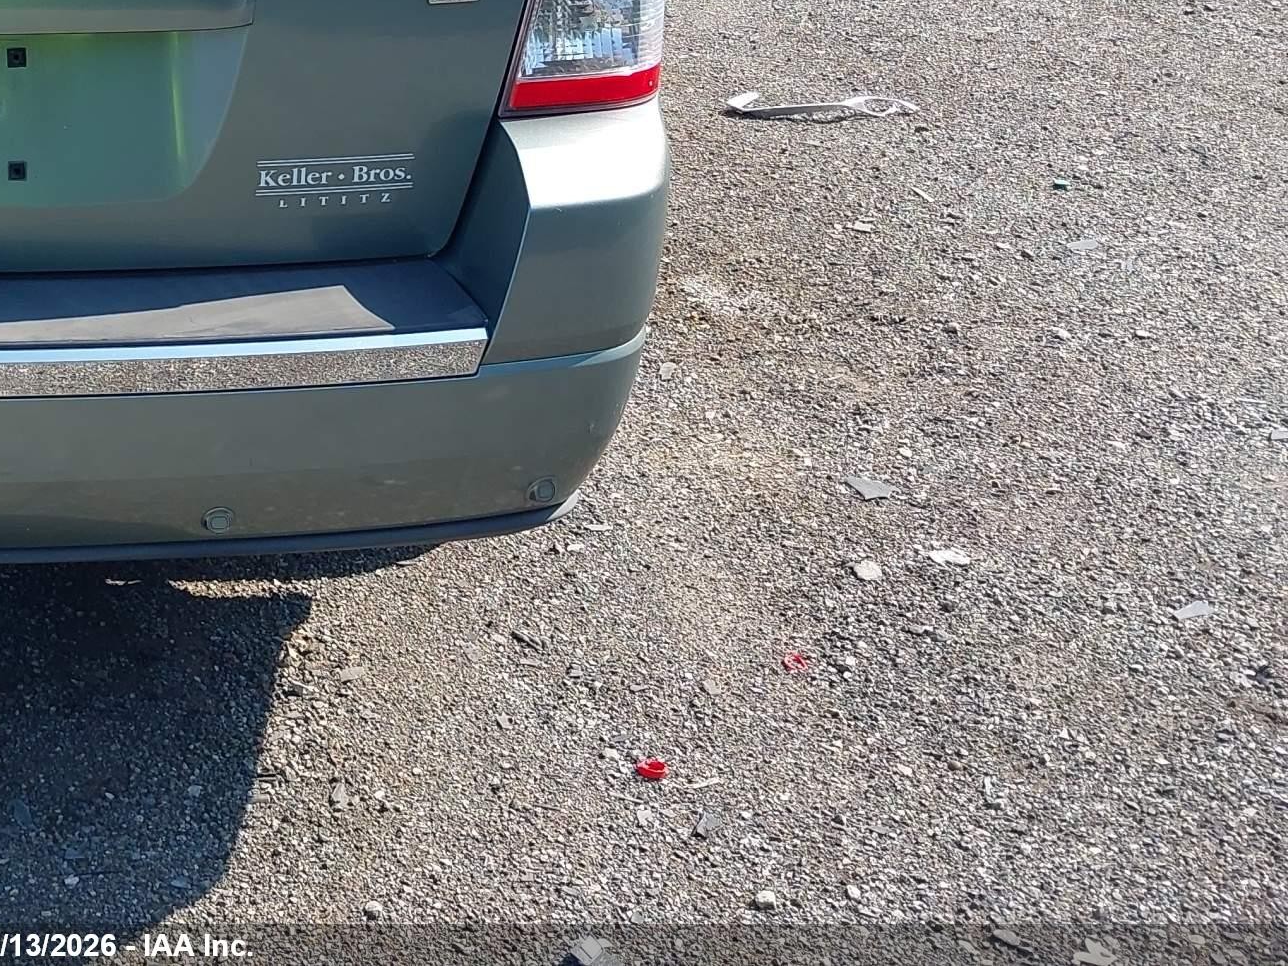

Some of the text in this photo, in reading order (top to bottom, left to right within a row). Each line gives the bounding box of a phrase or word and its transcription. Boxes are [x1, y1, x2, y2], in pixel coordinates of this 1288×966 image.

[258, 165, 412, 187] Keller Bros.
[278, 192, 392, 208] LITITZ
